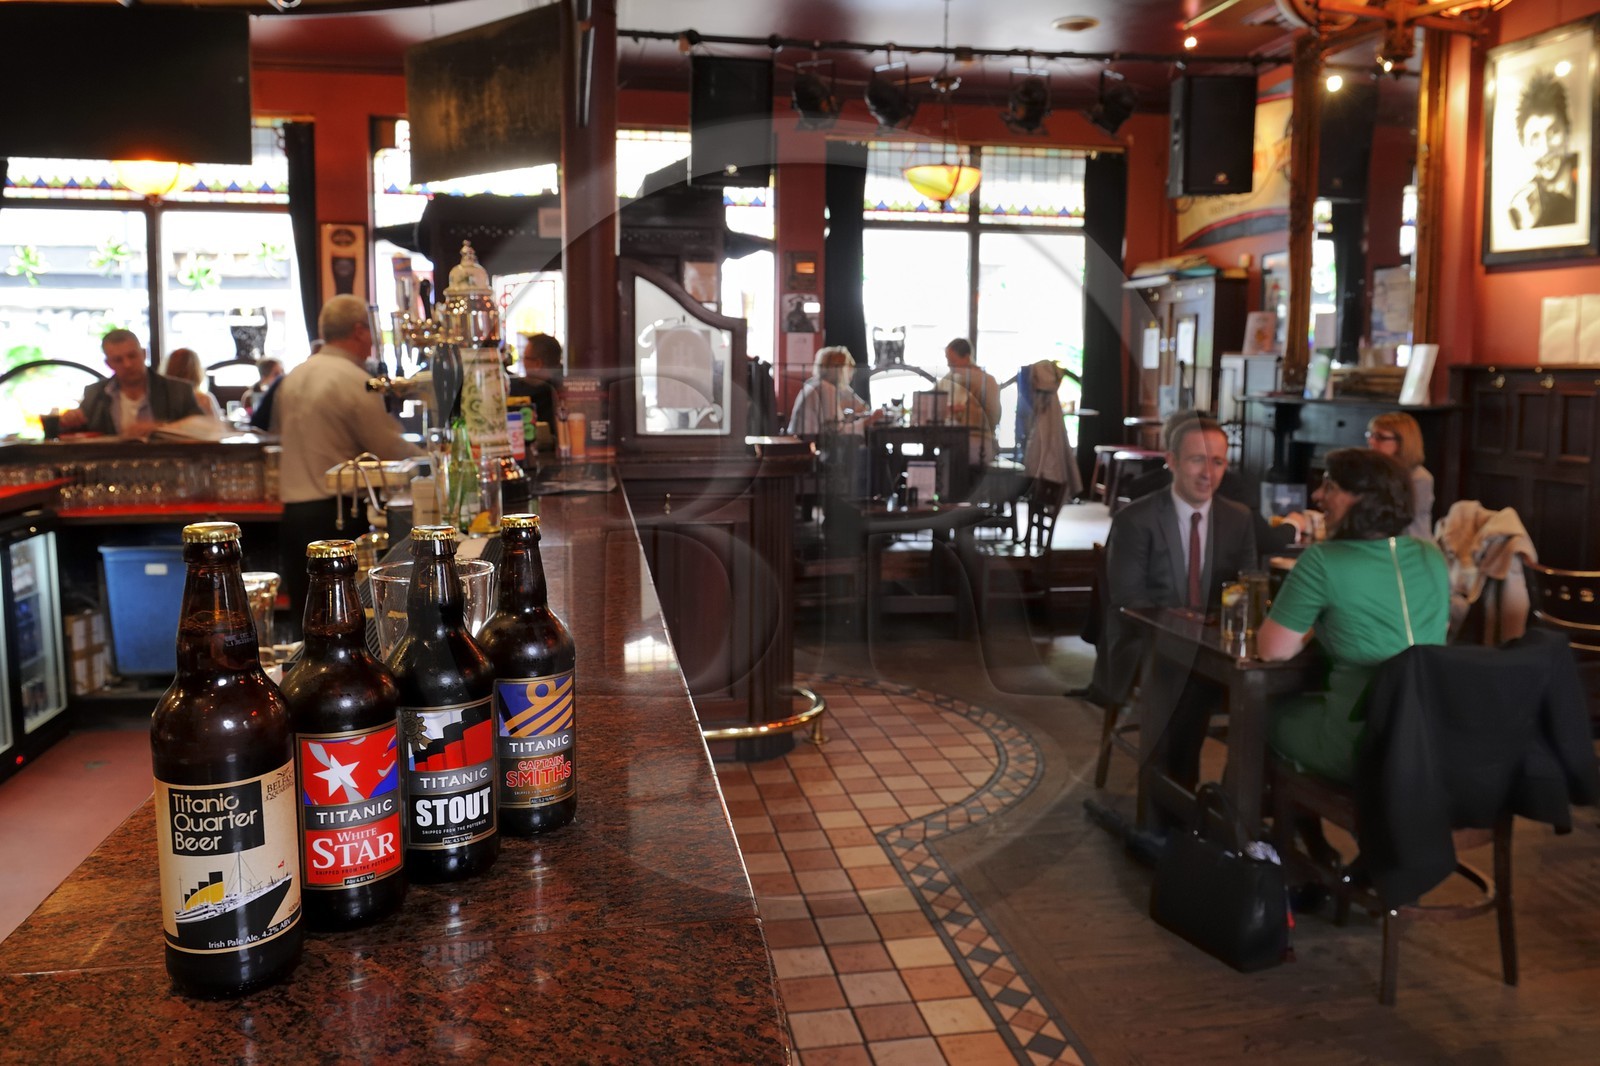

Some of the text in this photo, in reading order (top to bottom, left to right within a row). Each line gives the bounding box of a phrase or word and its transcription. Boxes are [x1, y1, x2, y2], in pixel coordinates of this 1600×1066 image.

[508, 734, 569, 753] TITANIC
[505, 760, 572, 788] SMITHS
[517, 754, 564, 771] CAPTAIN
[419, 767, 488, 789] TITANIC
[172, 793, 240, 814] Titanic
[316, 799, 393, 825] TITANIC
[415, 786, 491, 827] STOUT
[174, 809, 258, 832] Quarter
[174, 832, 223, 851] Beer
[312, 832, 396, 869] STAR
[208, 917, 292, 949] Irish Pale Ale, 4.2% ABV
